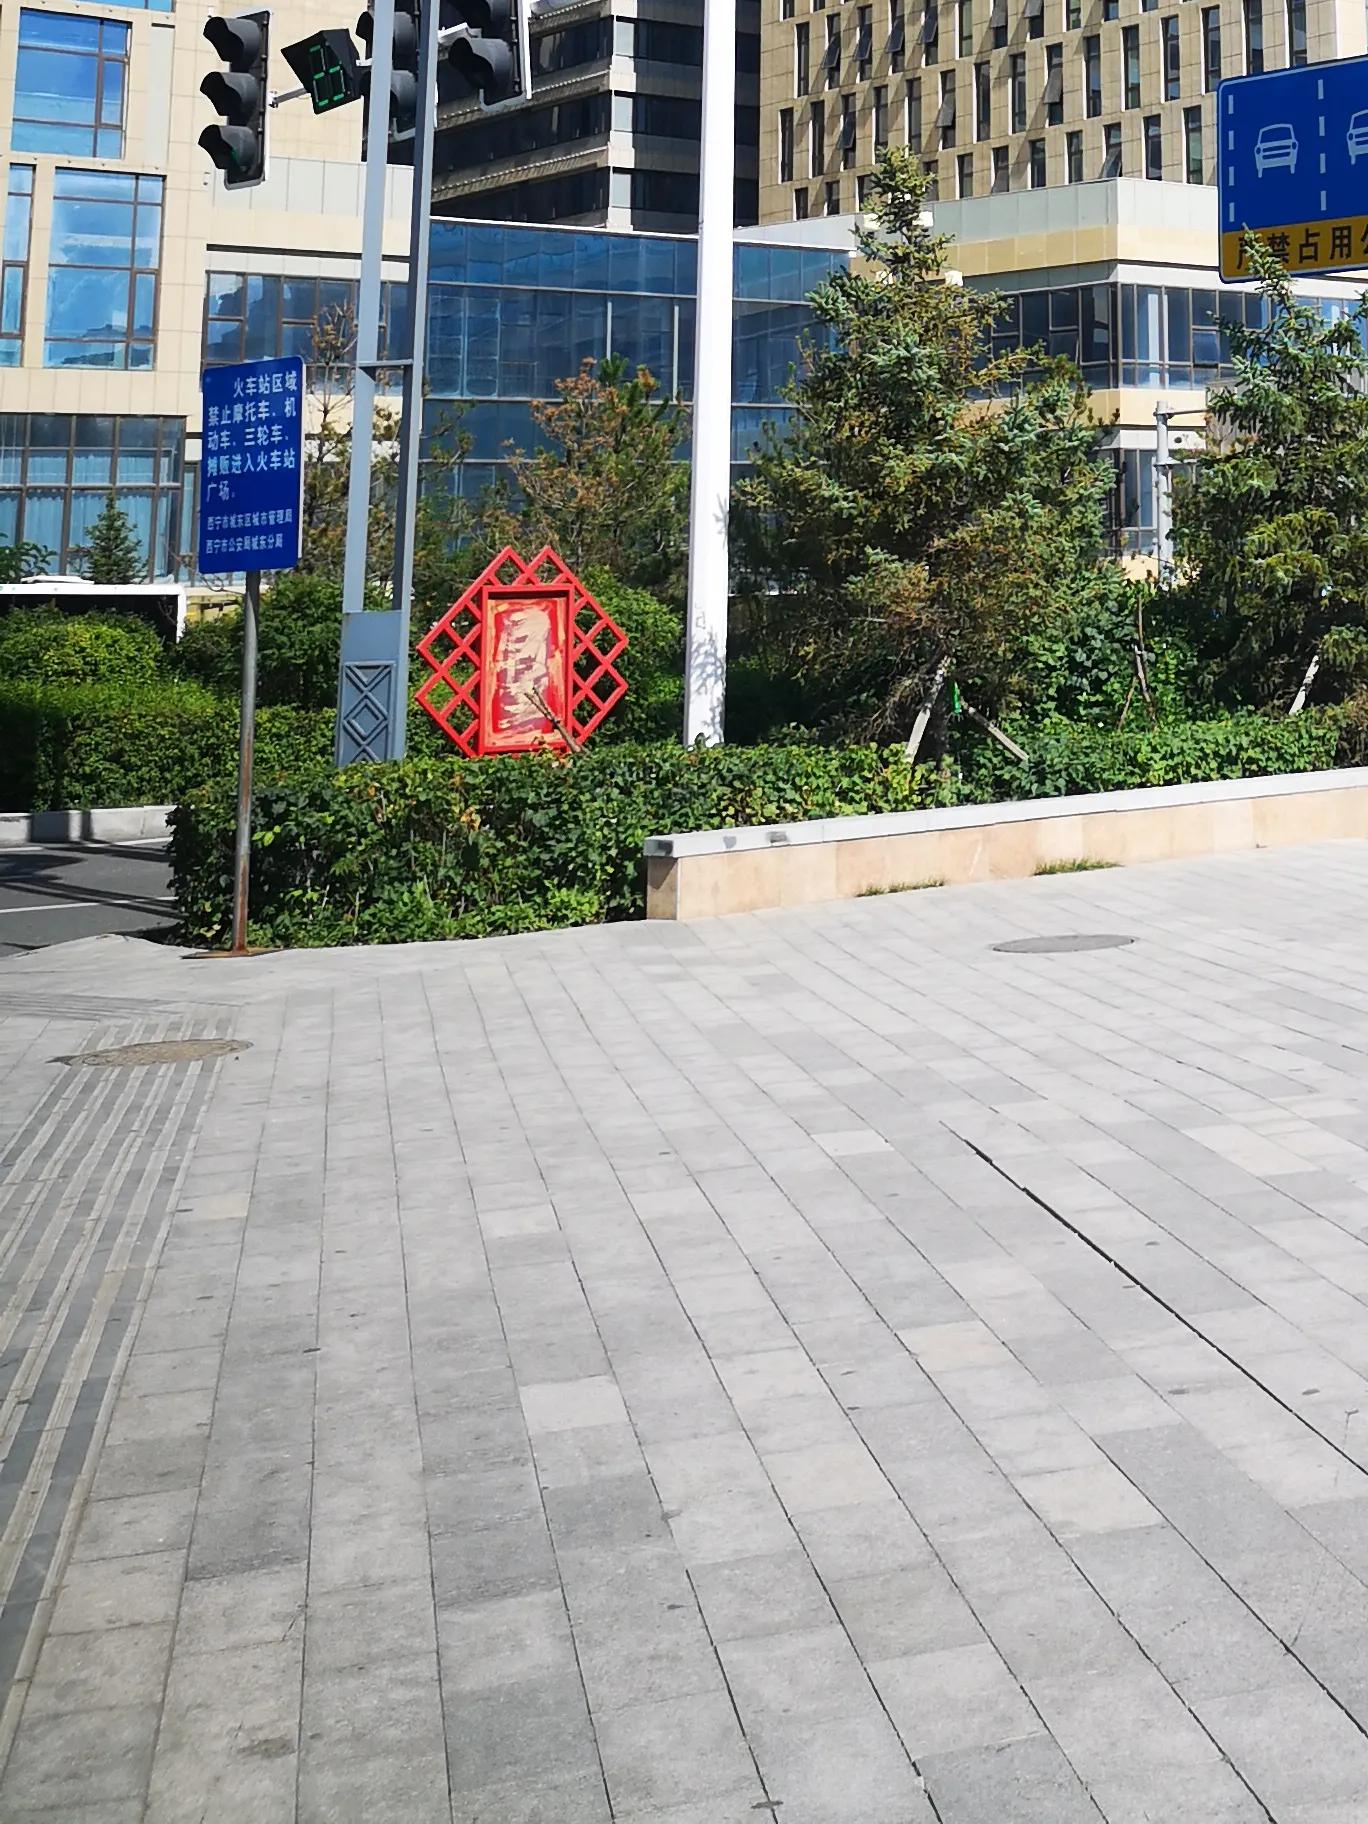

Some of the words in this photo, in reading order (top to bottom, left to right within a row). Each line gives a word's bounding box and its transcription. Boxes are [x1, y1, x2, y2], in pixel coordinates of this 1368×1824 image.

[233, 370, 298, 398] 火车站区域
[208, 397, 296, 427] 禁止摩托车、机
[207, 424, 289, 451] 动车、三轮车、
[207, 448, 296, 478] 摊贩进入火车站
[207, 508, 293, 531] 西宁市城东区城市管理局
[205, 533, 283, 554] 西宁市公安局城东分局
